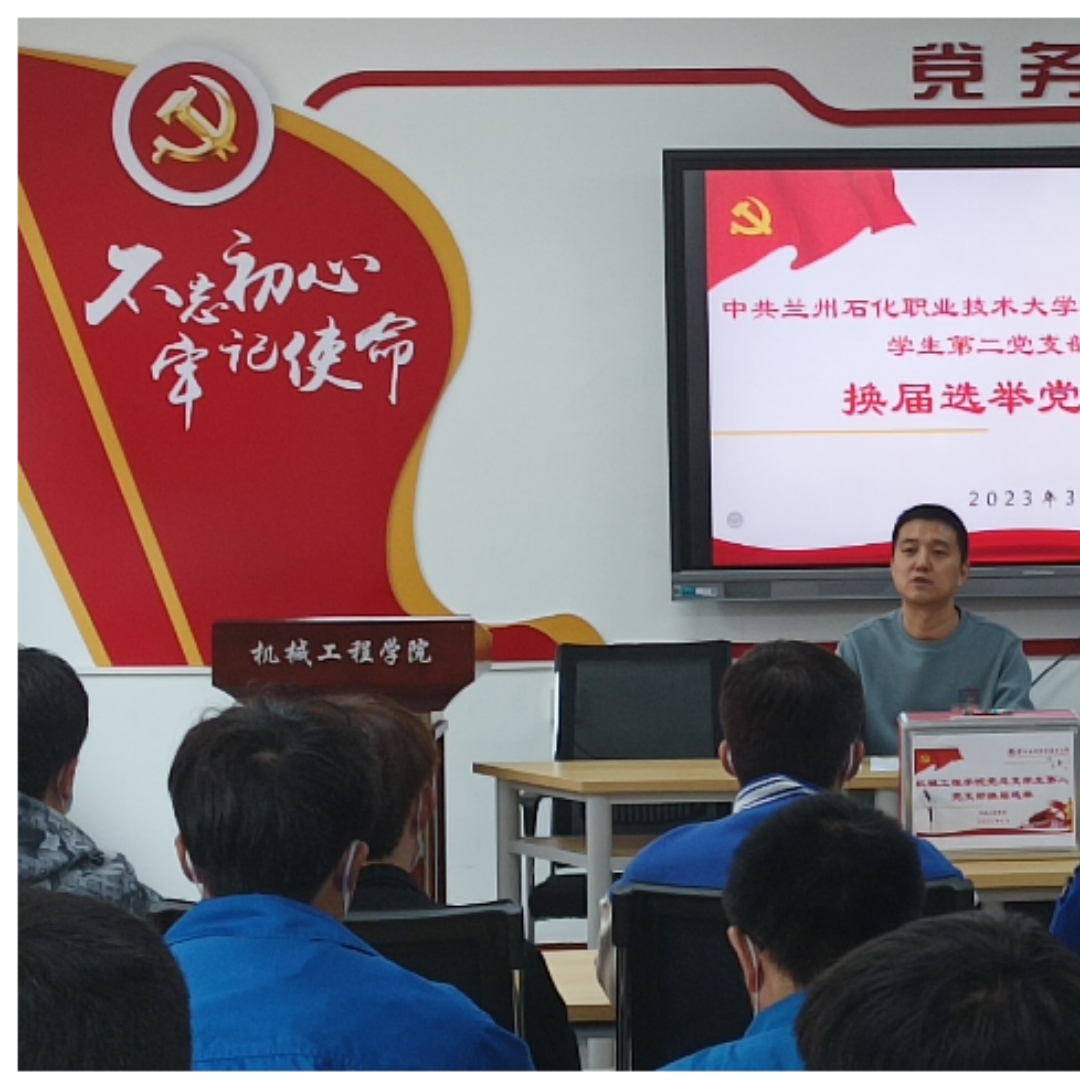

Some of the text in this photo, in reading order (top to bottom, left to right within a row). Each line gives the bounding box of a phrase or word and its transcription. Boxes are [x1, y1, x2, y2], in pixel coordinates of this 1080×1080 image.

[84, 228, 381, 328] 不忘初心
[151, 312, 418, 432] 牢记使命
[250, 638, 433, 668] 机械工程学院
